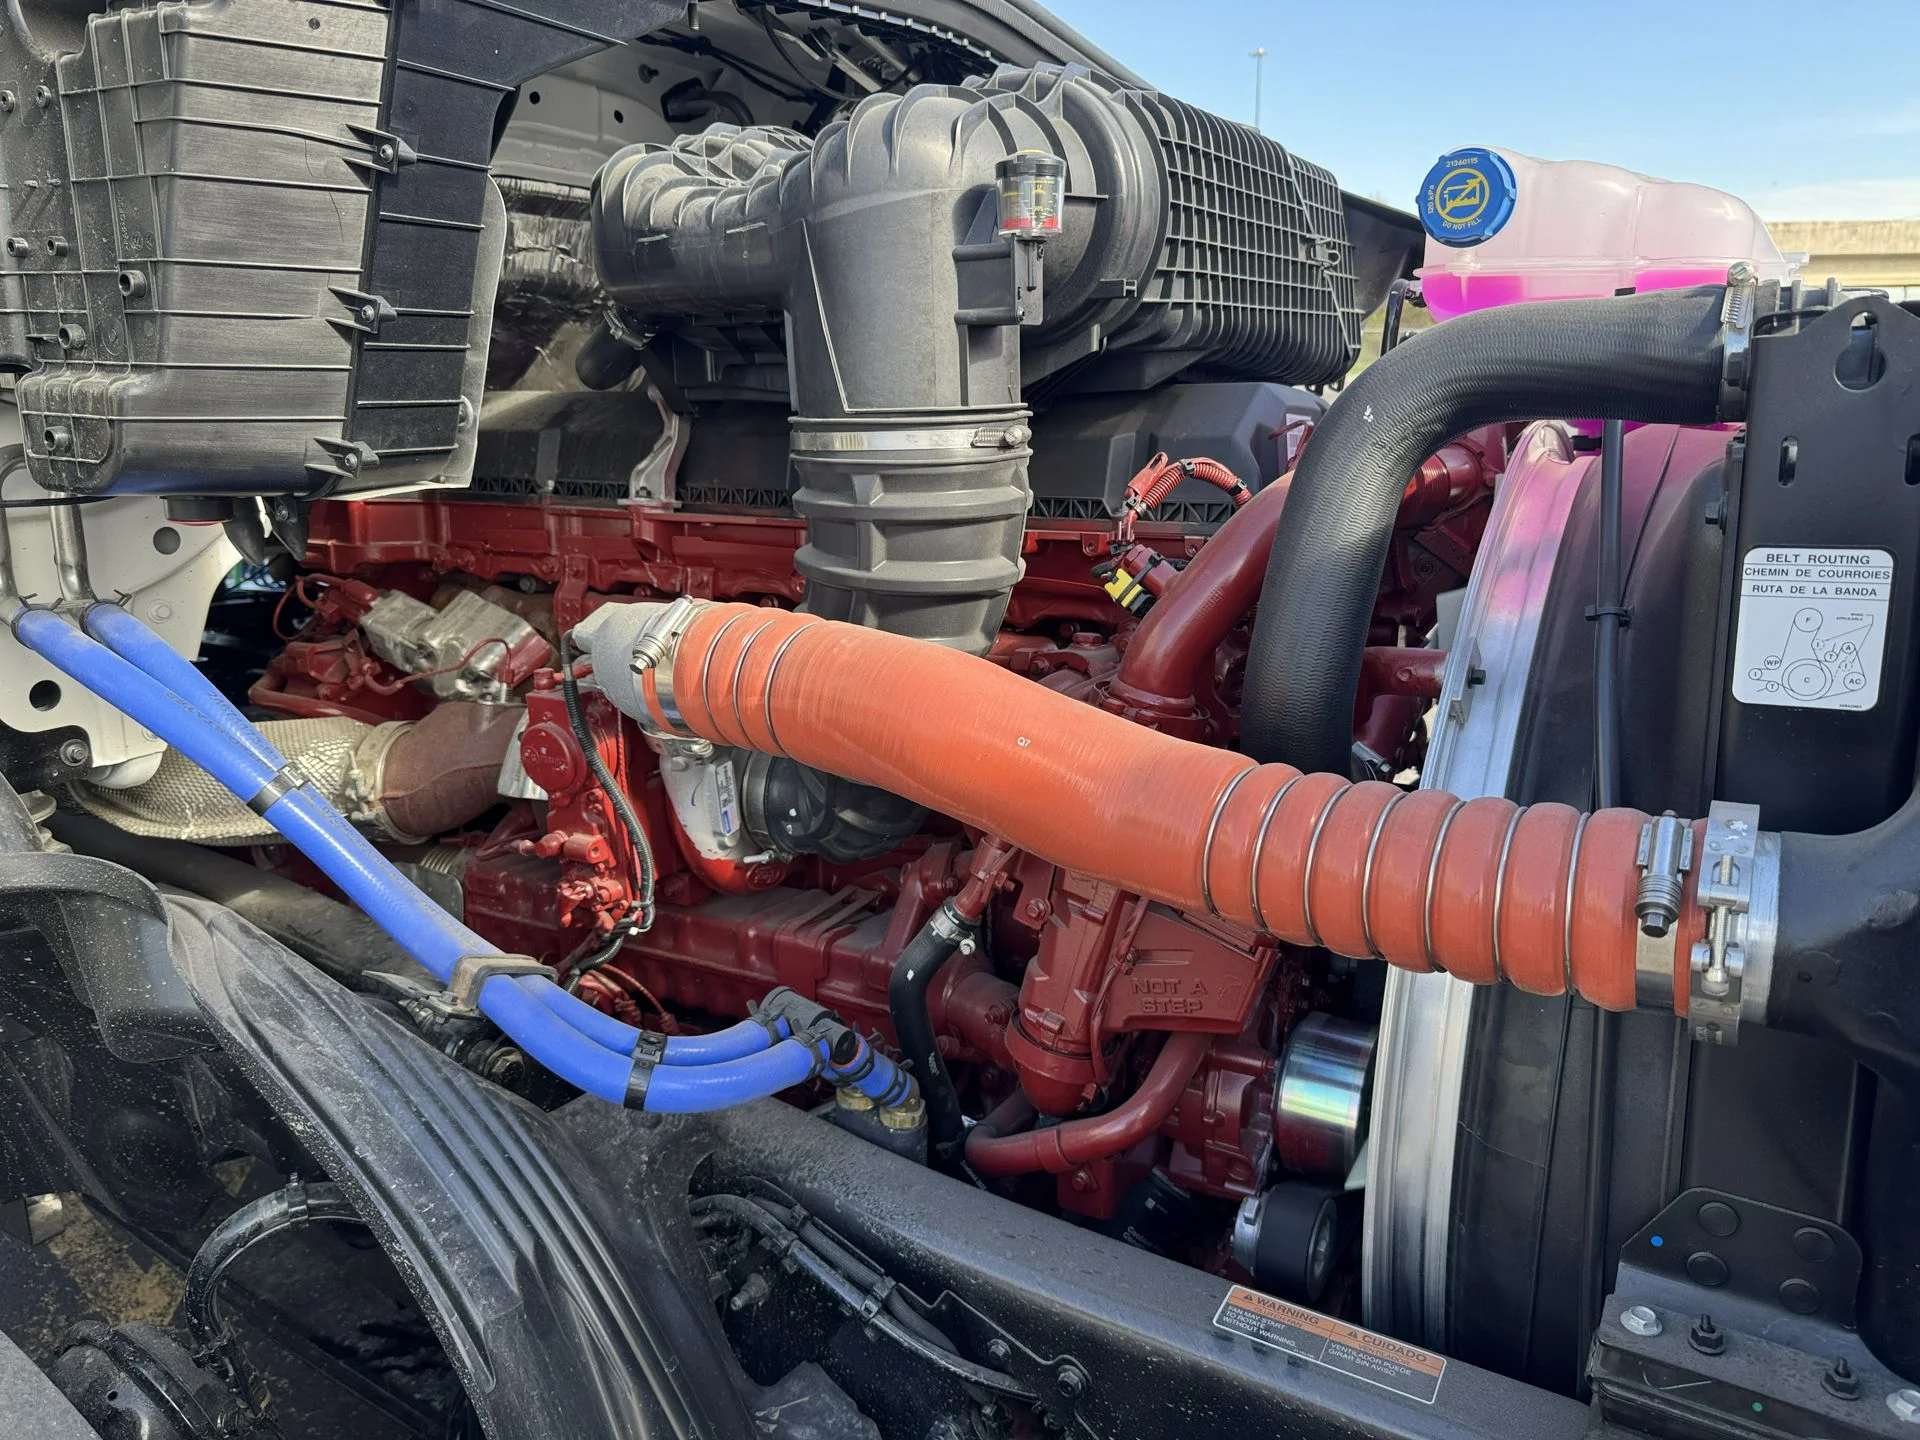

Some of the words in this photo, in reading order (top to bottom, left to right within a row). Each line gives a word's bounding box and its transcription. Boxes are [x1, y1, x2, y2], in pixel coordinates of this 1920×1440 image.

[1446, 157, 1478, 167] 21360115
[1442, 220, 1452, 229] DO
[1467, 217, 1482, 228] FILL
[1766, 553, 1800, 563] BELT
[1807, 554, 1870, 565] ROUTING
[1744, 567, 1789, 577] CHEMIN
[1795, 568, 1811, 577] DE
[1818, 569, 1890, 580] COURROIES
[1752, 584, 1783, 594] RUTA
[1790, 585, 1806, 594] DE
[1812, 586, 1828, 595] LA
[1834, 587, 1877, 597] BANDA
[1132, 977, 1181, 995] NOT
[1190, 978, 1208, 995] A
[1142, 997, 1203, 1014] STEP
[1226, 1311, 1236, 1319] TO
[1237, 1314, 1266, 1329] ROTATE
[1228, 1305, 1243, 1315] FAN
[1244, 1311, 1260, 1321] MAY
[1261, 1318, 1287, 1330] START
[1256, 1297, 1320, 1325] WARNING
[1223, 1316, 1258, 1333] WITHOUT
[1259, 1329, 1297, 1348] WARNING.
[1358, 1343, 1410, 1367] VENTILADOR
[1362, 1334, 1427, 1362] CUIDADO
[1328, 1348, 1354, 1361] GIRAR
[1355, 1358, 1370, 1368] SIN
[1331, 1342, 1382, 1365] VENTILADOR
[1383, 1361, 1412, 1376] PUEDE
